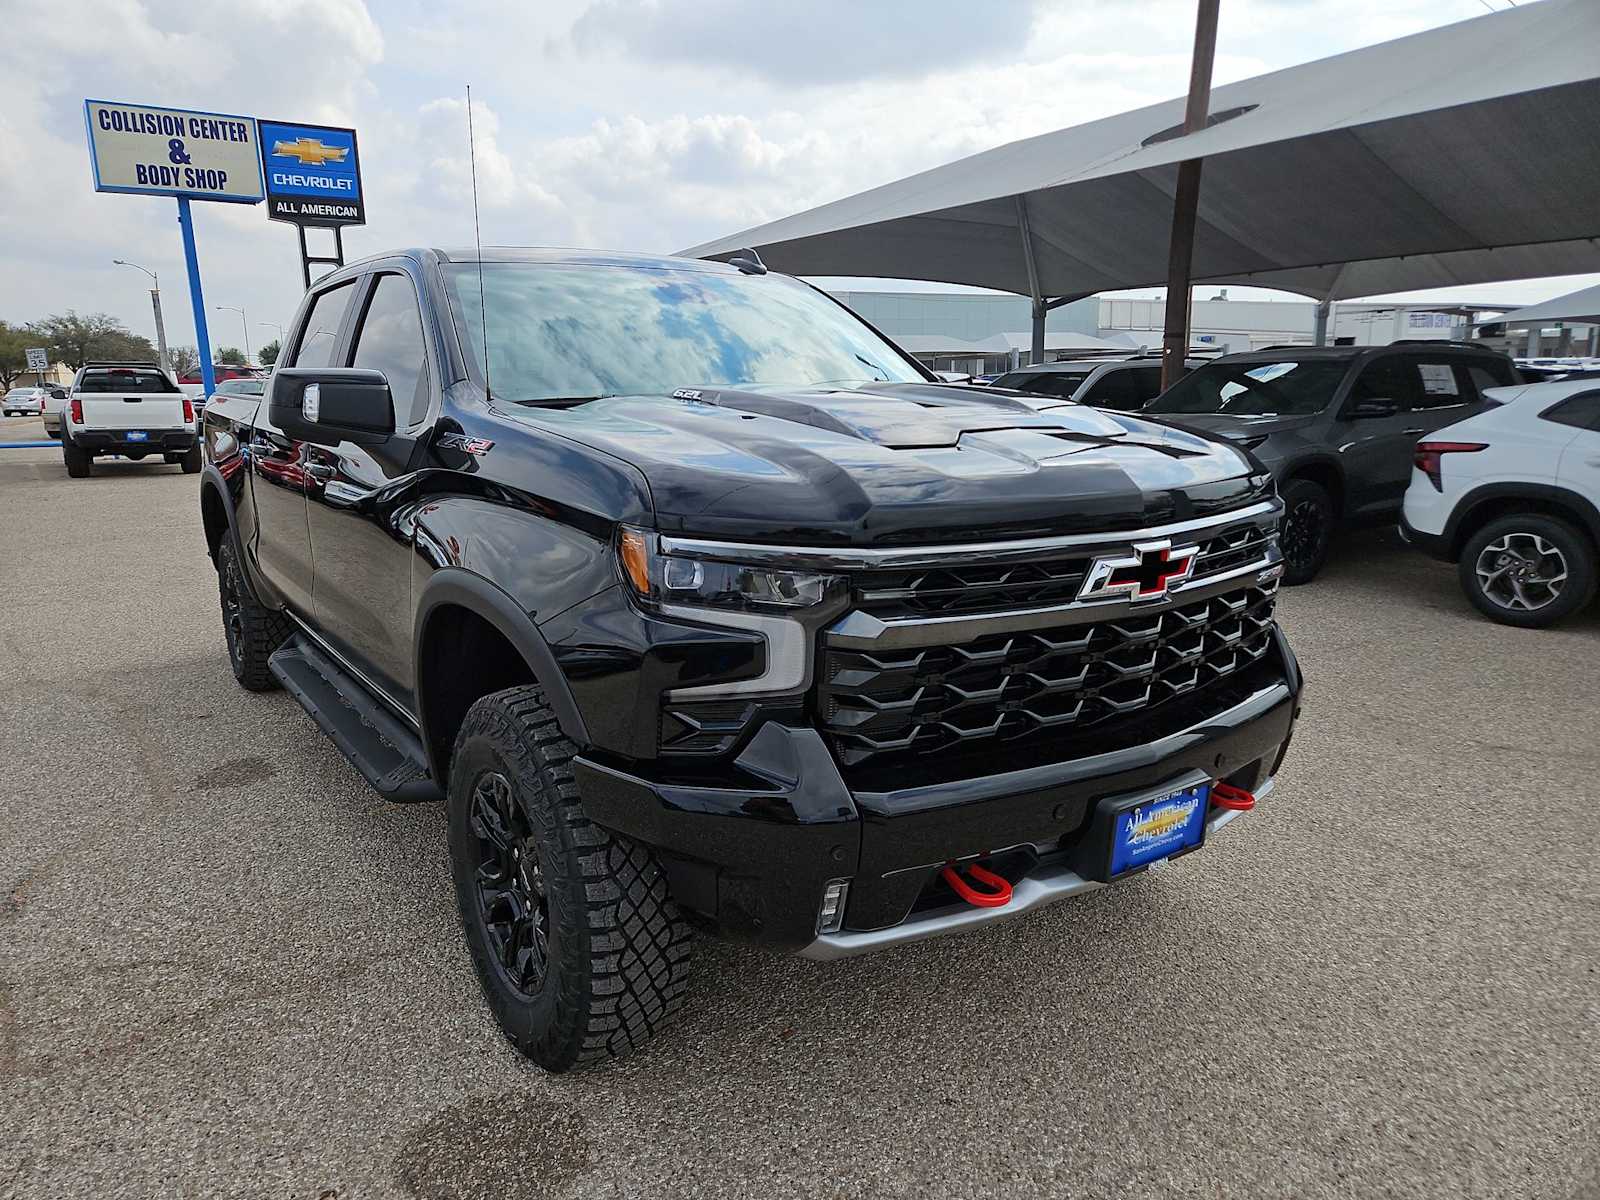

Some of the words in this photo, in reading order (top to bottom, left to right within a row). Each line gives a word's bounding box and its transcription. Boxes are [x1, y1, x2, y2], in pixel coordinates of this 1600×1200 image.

[99, 109, 185, 137] COLLISION
[189, 118, 248, 142] CENTER
[168, 138, 191, 165] &
[136, 164, 180, 187] BODY
[184, 167, 227, 190] SHOP
[273, 173, 353, 190] CHEVROLET
[276, 202, 298, 213] ALL
[301, 204, 358, 217] AMERICAN
[31, 359, 46, 367] 35
[436, 431, 496, 456] ZR2
[1125, 813, 1143, 832] All
[1148, 798, 1199, 822] American
[1131, 816, 1188, 845] Chevrolet
